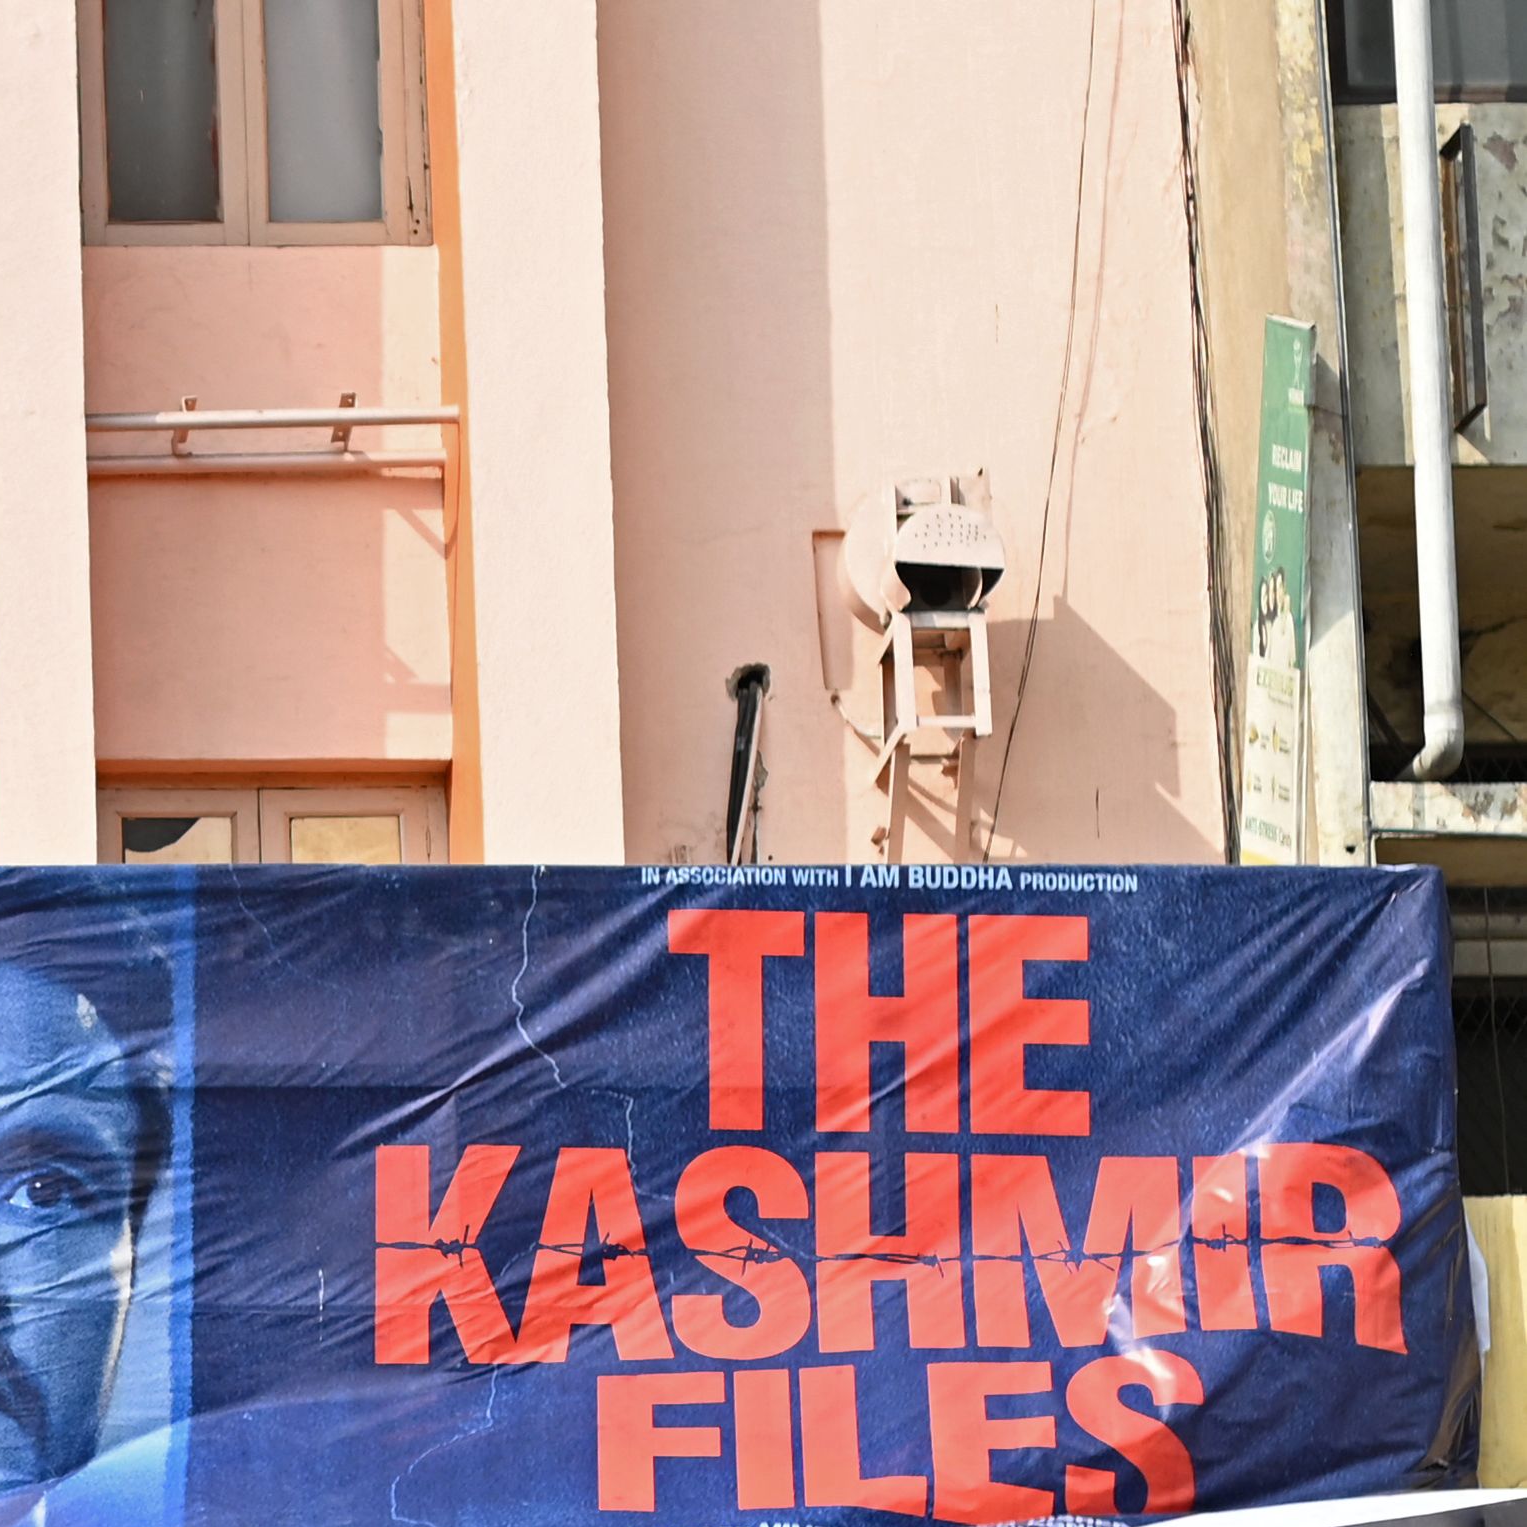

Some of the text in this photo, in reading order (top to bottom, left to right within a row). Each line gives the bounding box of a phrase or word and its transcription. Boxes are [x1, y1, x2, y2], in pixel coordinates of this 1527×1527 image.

[1268, 482, 1304, 514] YOUR LIFE
[1272, 444, 1302, 473] RECLAIM
[641, 865, 1138, 893] IN ASSOCIATION WITH I AM BUDDHA PRODUCTION
[668, 909, 1089, 1137] THE
[374, 1143, 1407, 1364] KASHMIR
[596, 1352, 1204, 1524] FILES
